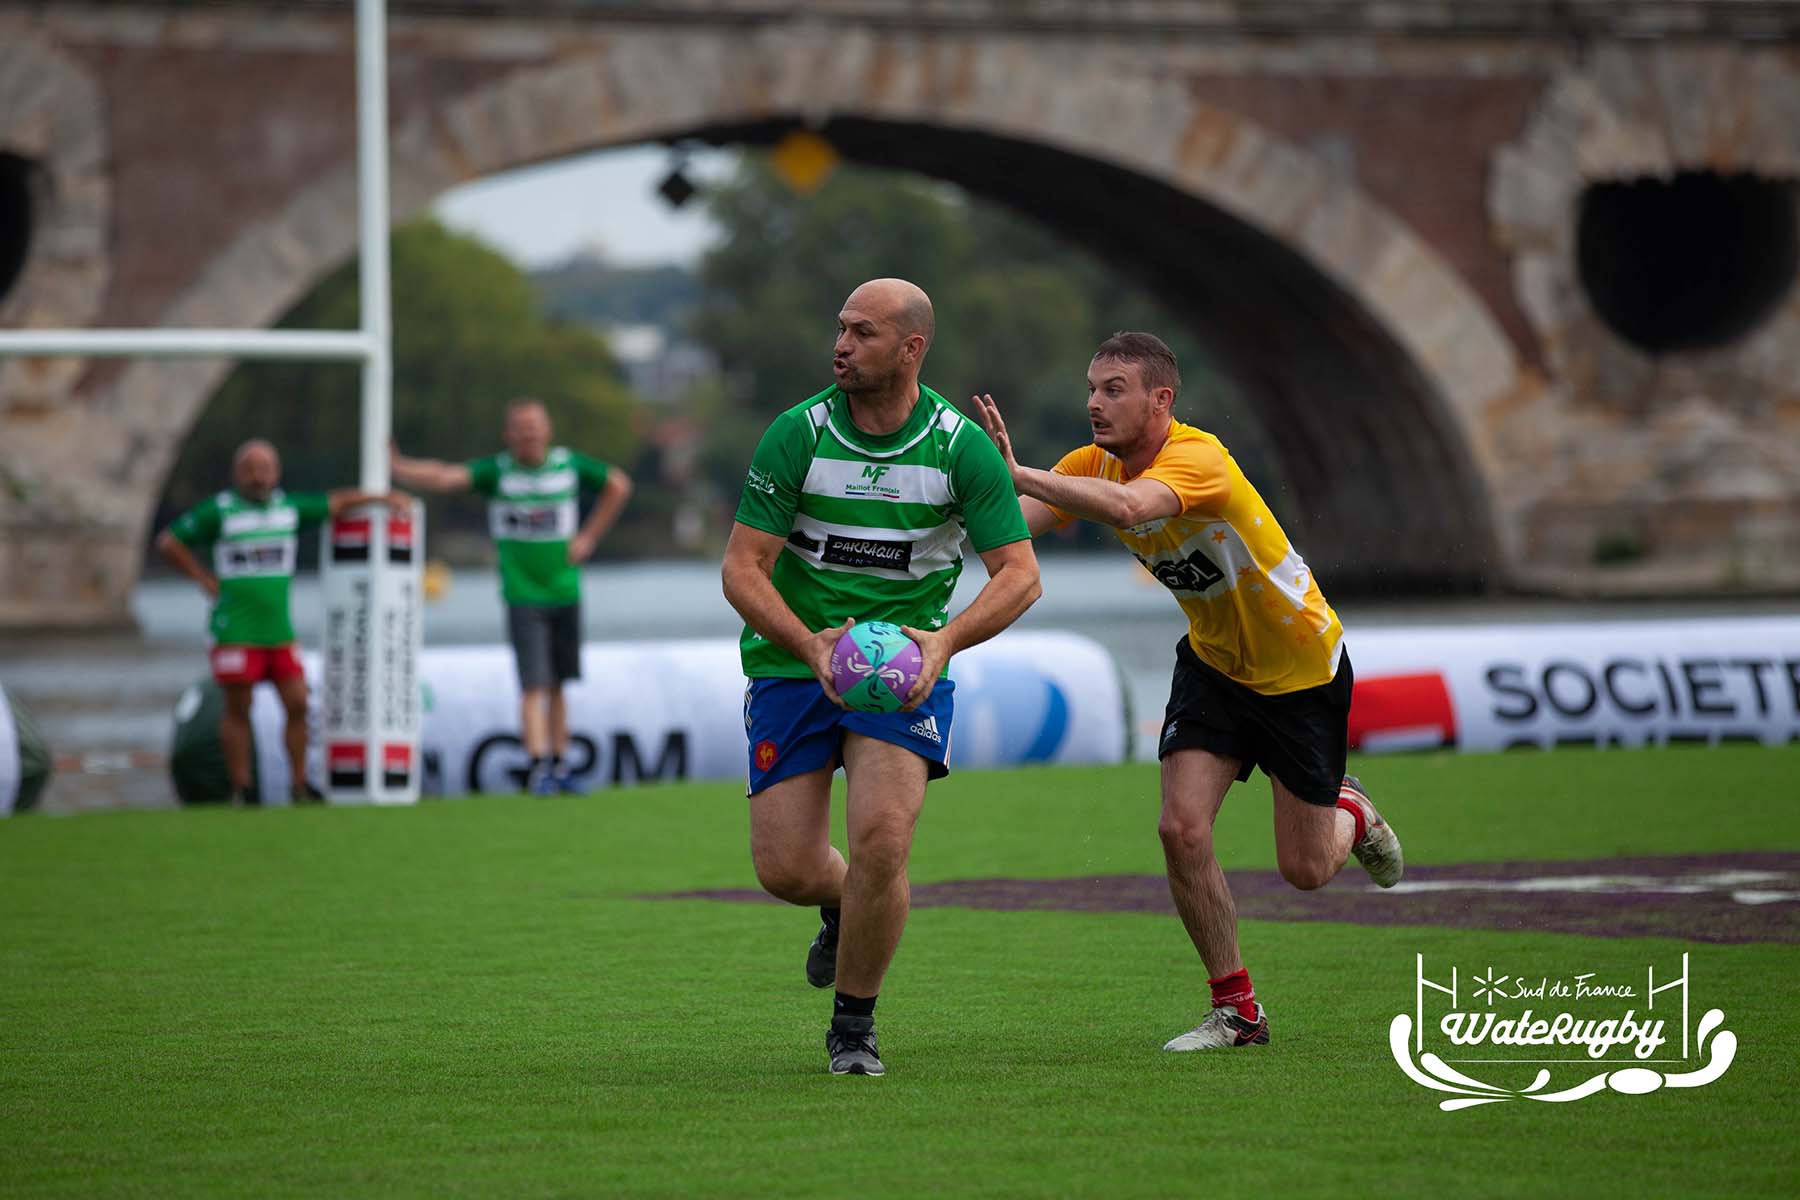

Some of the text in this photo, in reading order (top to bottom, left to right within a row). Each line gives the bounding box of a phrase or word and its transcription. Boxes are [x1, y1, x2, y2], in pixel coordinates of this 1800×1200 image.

[863, 465, 890, 484] MF
[846, 483, 871, 491] Maillot
[910, 723, 942, 743] adidas
